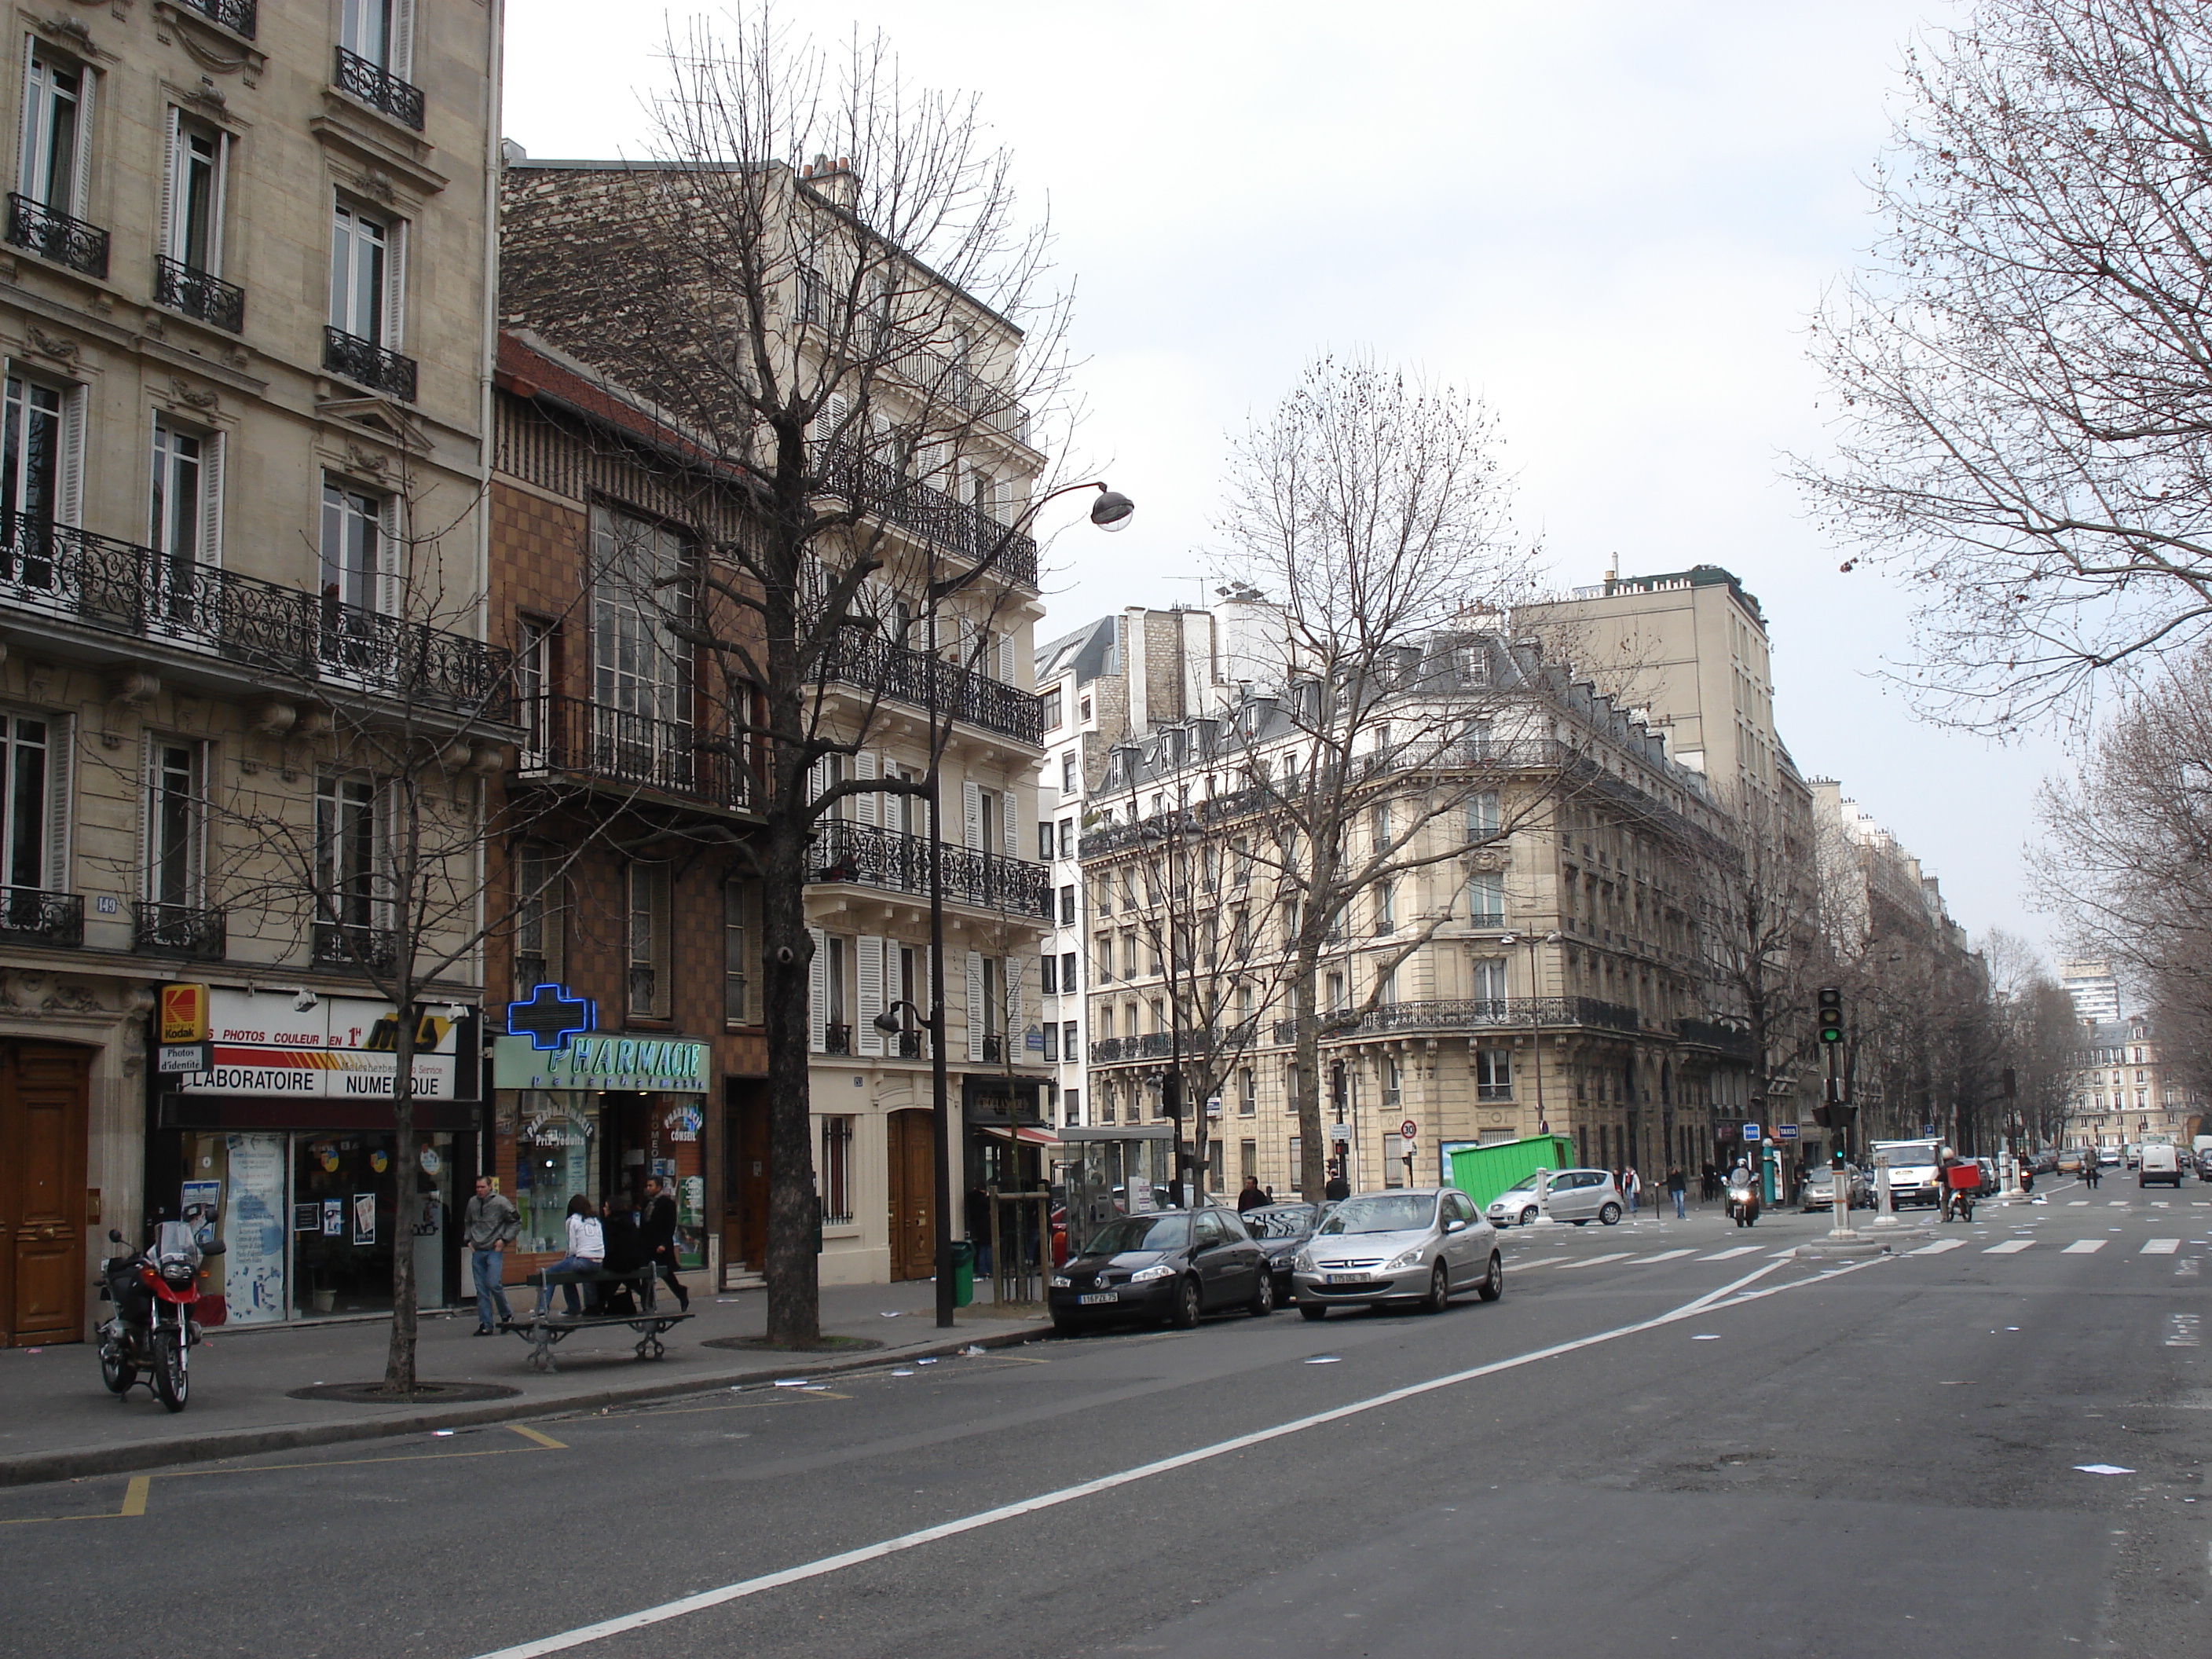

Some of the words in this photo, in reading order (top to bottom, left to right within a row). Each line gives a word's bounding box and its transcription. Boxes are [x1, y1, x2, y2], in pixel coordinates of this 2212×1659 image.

[99, 898, 115, 912] 149
[165, 1028, 195, 1038] Kodak
[222, 1029, 266, 1042] PHOTOS
[273, 1032, 320, 1046] COULEUR
[329, 1036, 342, 1046] EN
[167, 1049, 194, 1057] Photos
[548, 1038, 701, 1078] PHARMACIE
[419, 1064, 443, 1075] Service
[192, 1069, 314, 1091] LABORATOIRE
[346, 1075, 439, 1095] NUMEQUE
[664, 1106, 703, 1130] PHARMACIE
[671, 1130, 697, 1142] CONSEIL
[1404, 1126, 1413, 1134] 30
